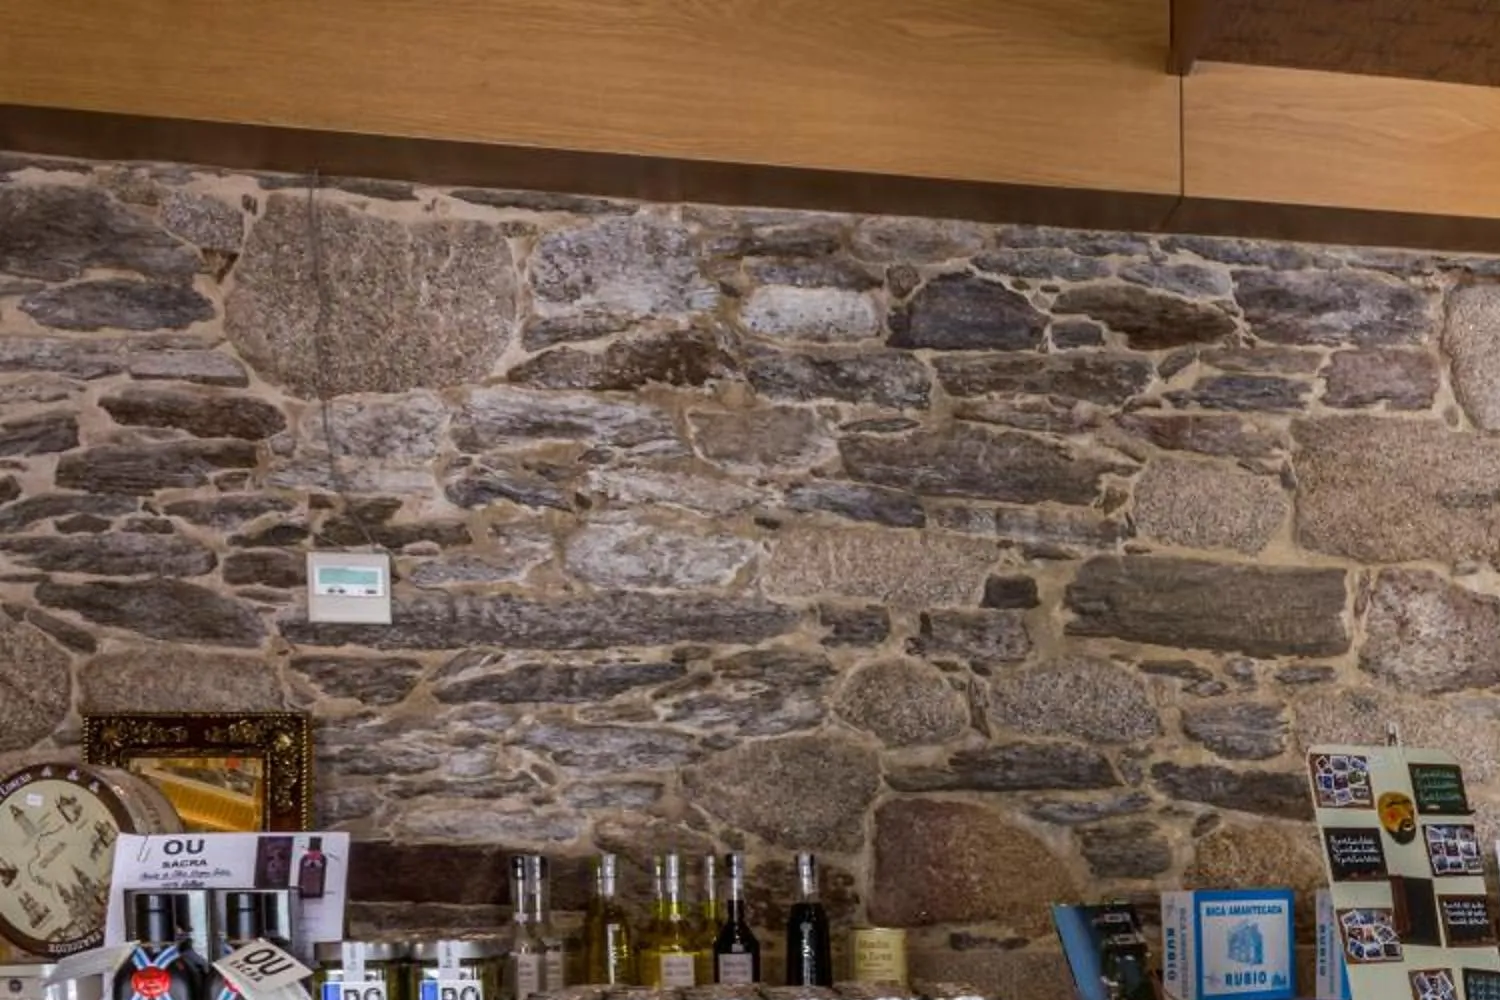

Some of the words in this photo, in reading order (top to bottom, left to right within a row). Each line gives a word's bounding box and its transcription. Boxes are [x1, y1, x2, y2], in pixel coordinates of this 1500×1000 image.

[163, 839, 205, 855] OU
[161, 859, 208, 869] SACRA
[1206, 906, 1226, 916] BICA
[1228, 904, 1283, 915] AMANTECADA
[1166, 927, 1177, 981] RUBIO
[243, 949, 295, 976] OU
[1225, 971, 1268, 986] RUBIO
